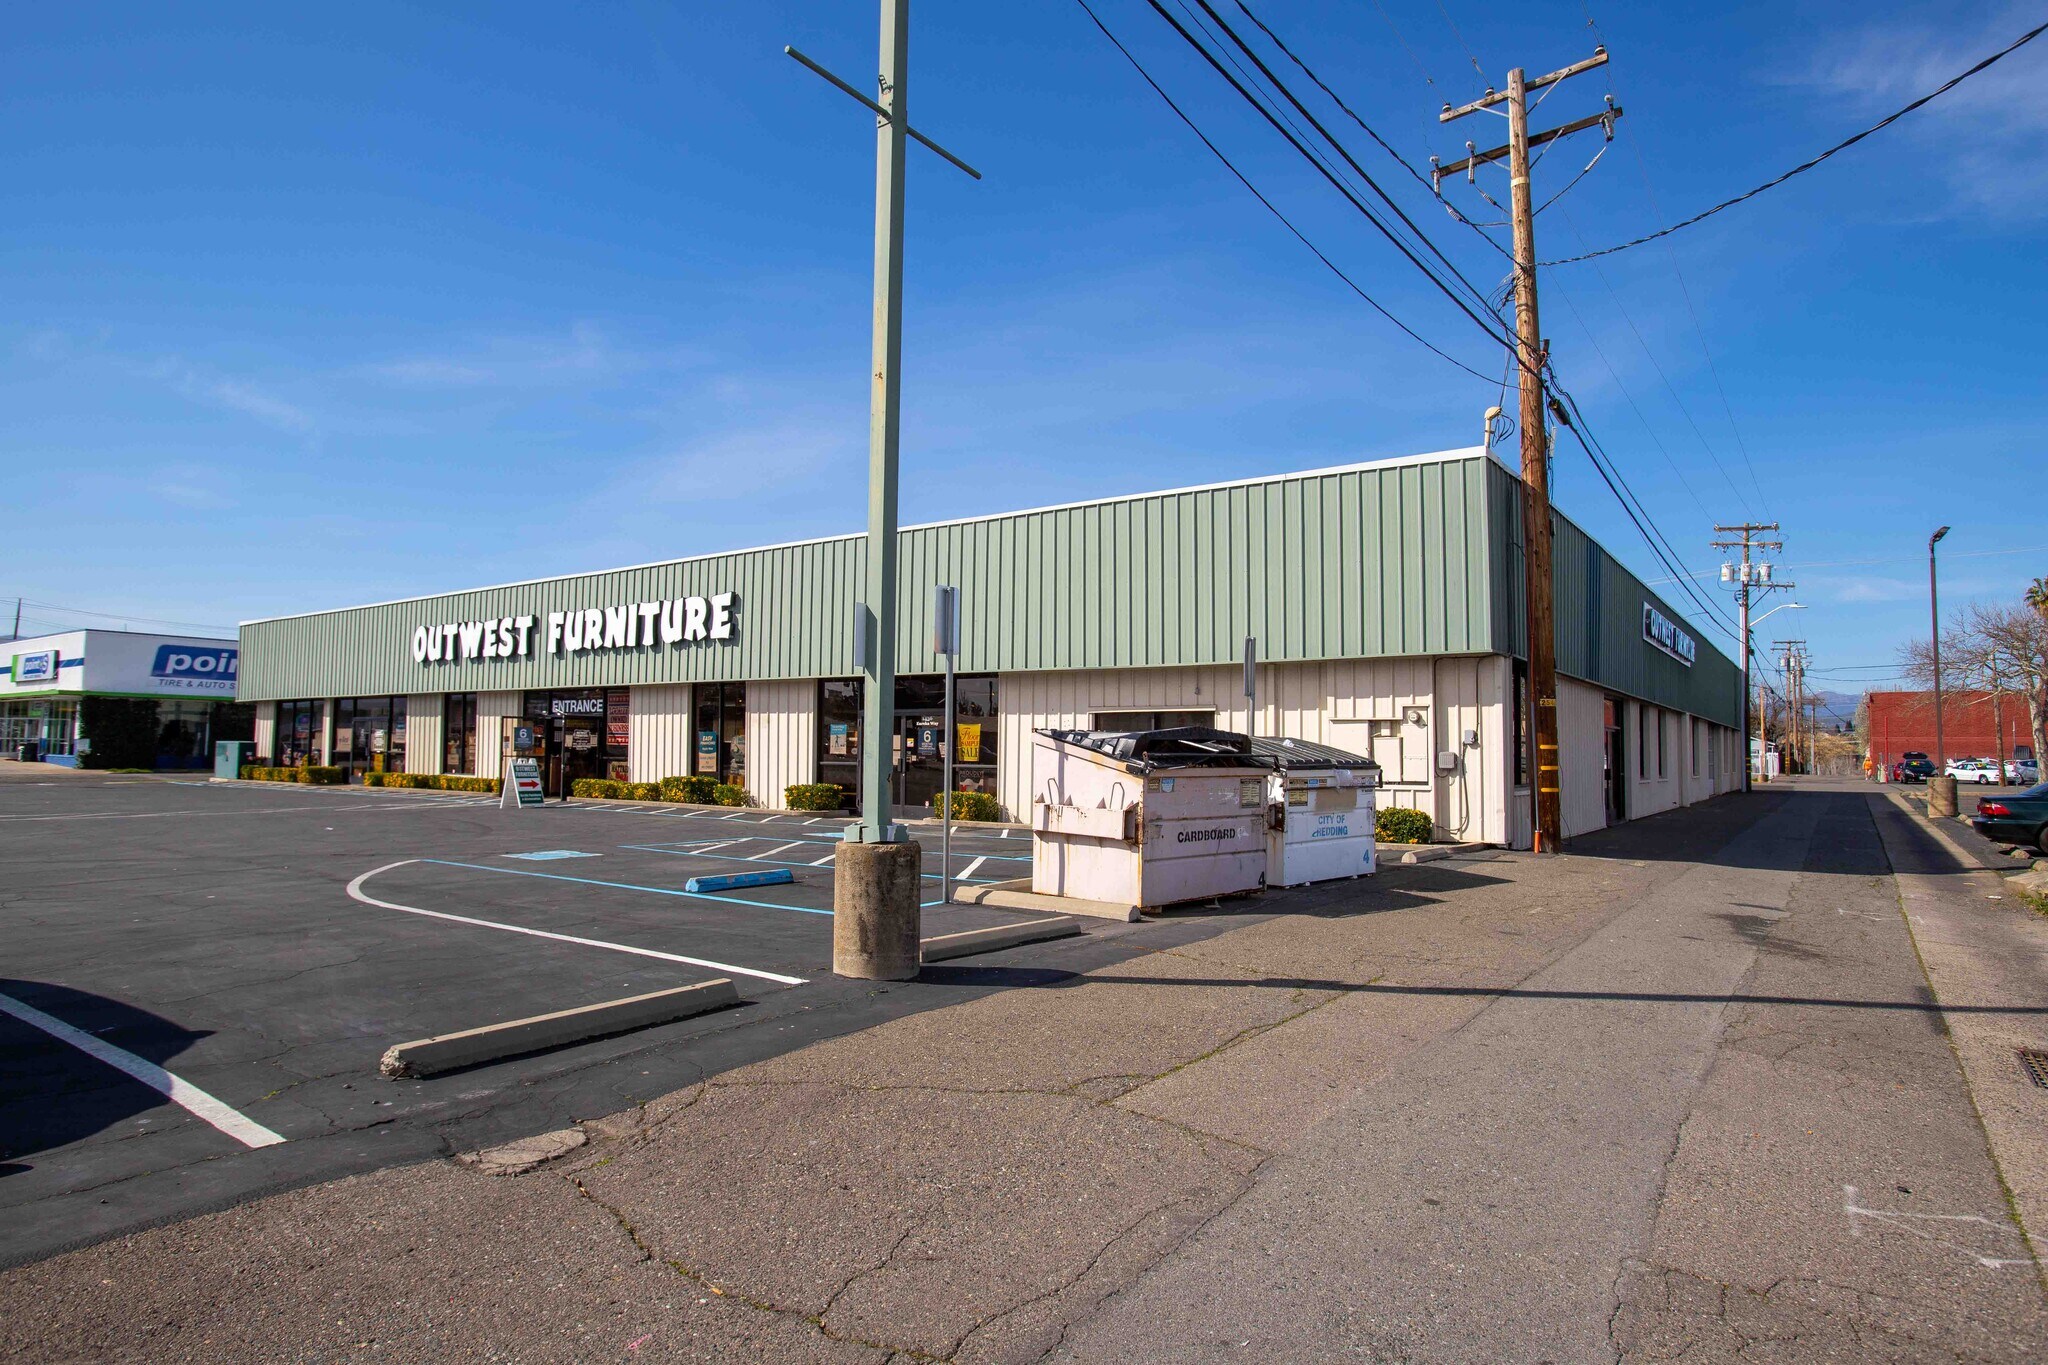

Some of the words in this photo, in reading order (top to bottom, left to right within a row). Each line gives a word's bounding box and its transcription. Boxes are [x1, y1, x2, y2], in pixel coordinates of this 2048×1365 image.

[413, 614, 534, 663] OUTWEST
[547, 591, 735, 654] FURNITURE
[160, 679, 182, 687] TIRE
[197, 681, 226, 689] AUTO
[552, 698, 603, 713] ENTRANCE
[520, 728, 527, 738] 6
[923, 730, 931, 742] 6
[1318, 815, 1335, 825] CITY
[1336, 814, 1345, 824] OF
[1177, 828, 1236, 843] CARDBOARD
[1363, 849, 1370, 864] 4
[1258, 871, 1266, 888] 4
